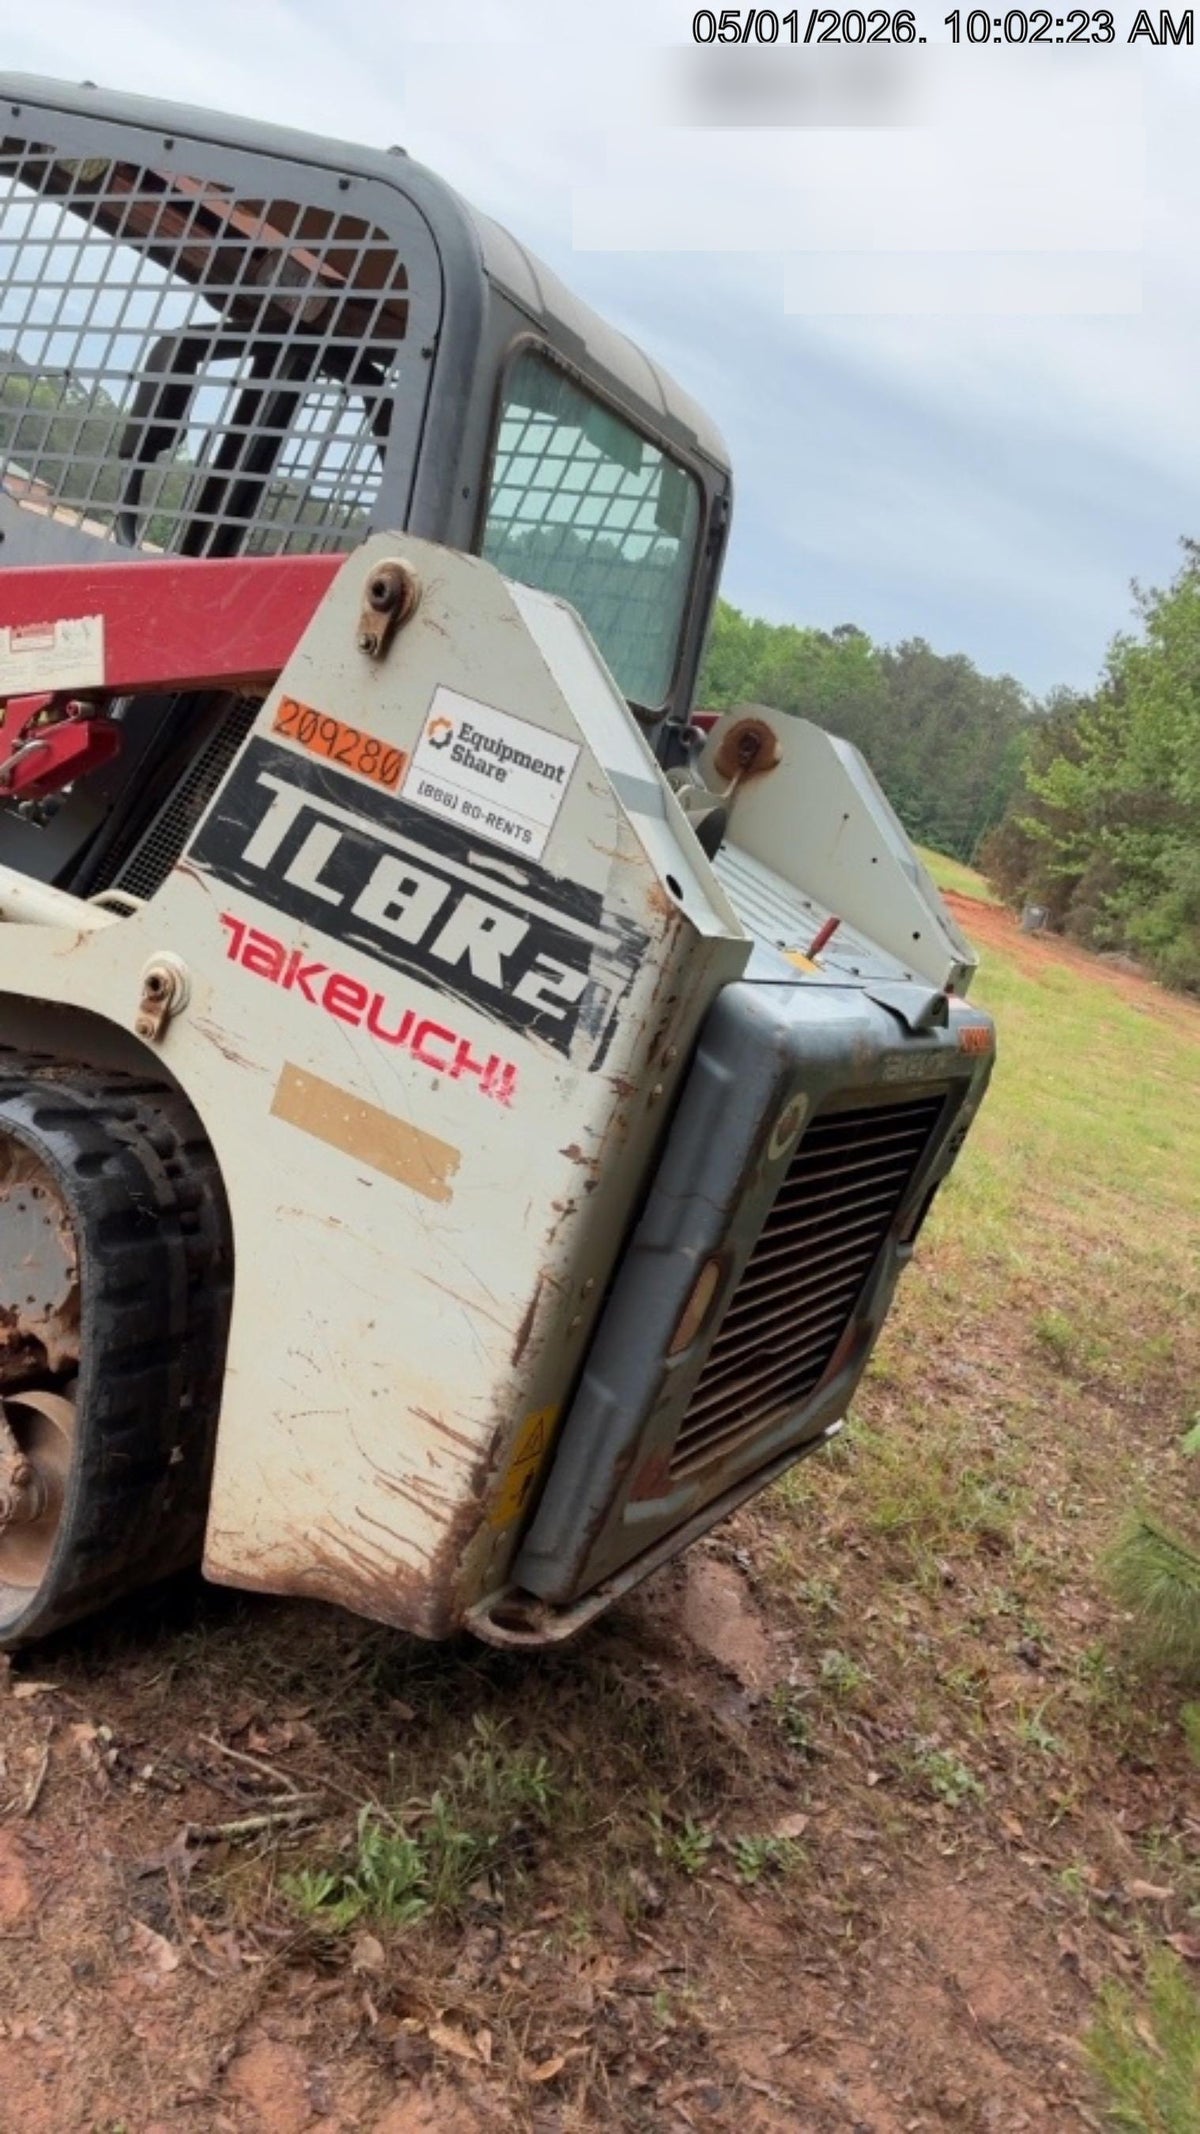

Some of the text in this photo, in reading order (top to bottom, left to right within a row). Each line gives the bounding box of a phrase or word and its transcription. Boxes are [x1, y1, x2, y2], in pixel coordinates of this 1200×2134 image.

[273, 700, 406, 785] 209280
[451, 744, 509, 783] Share
[457, 722, 566, 783] Equipment
